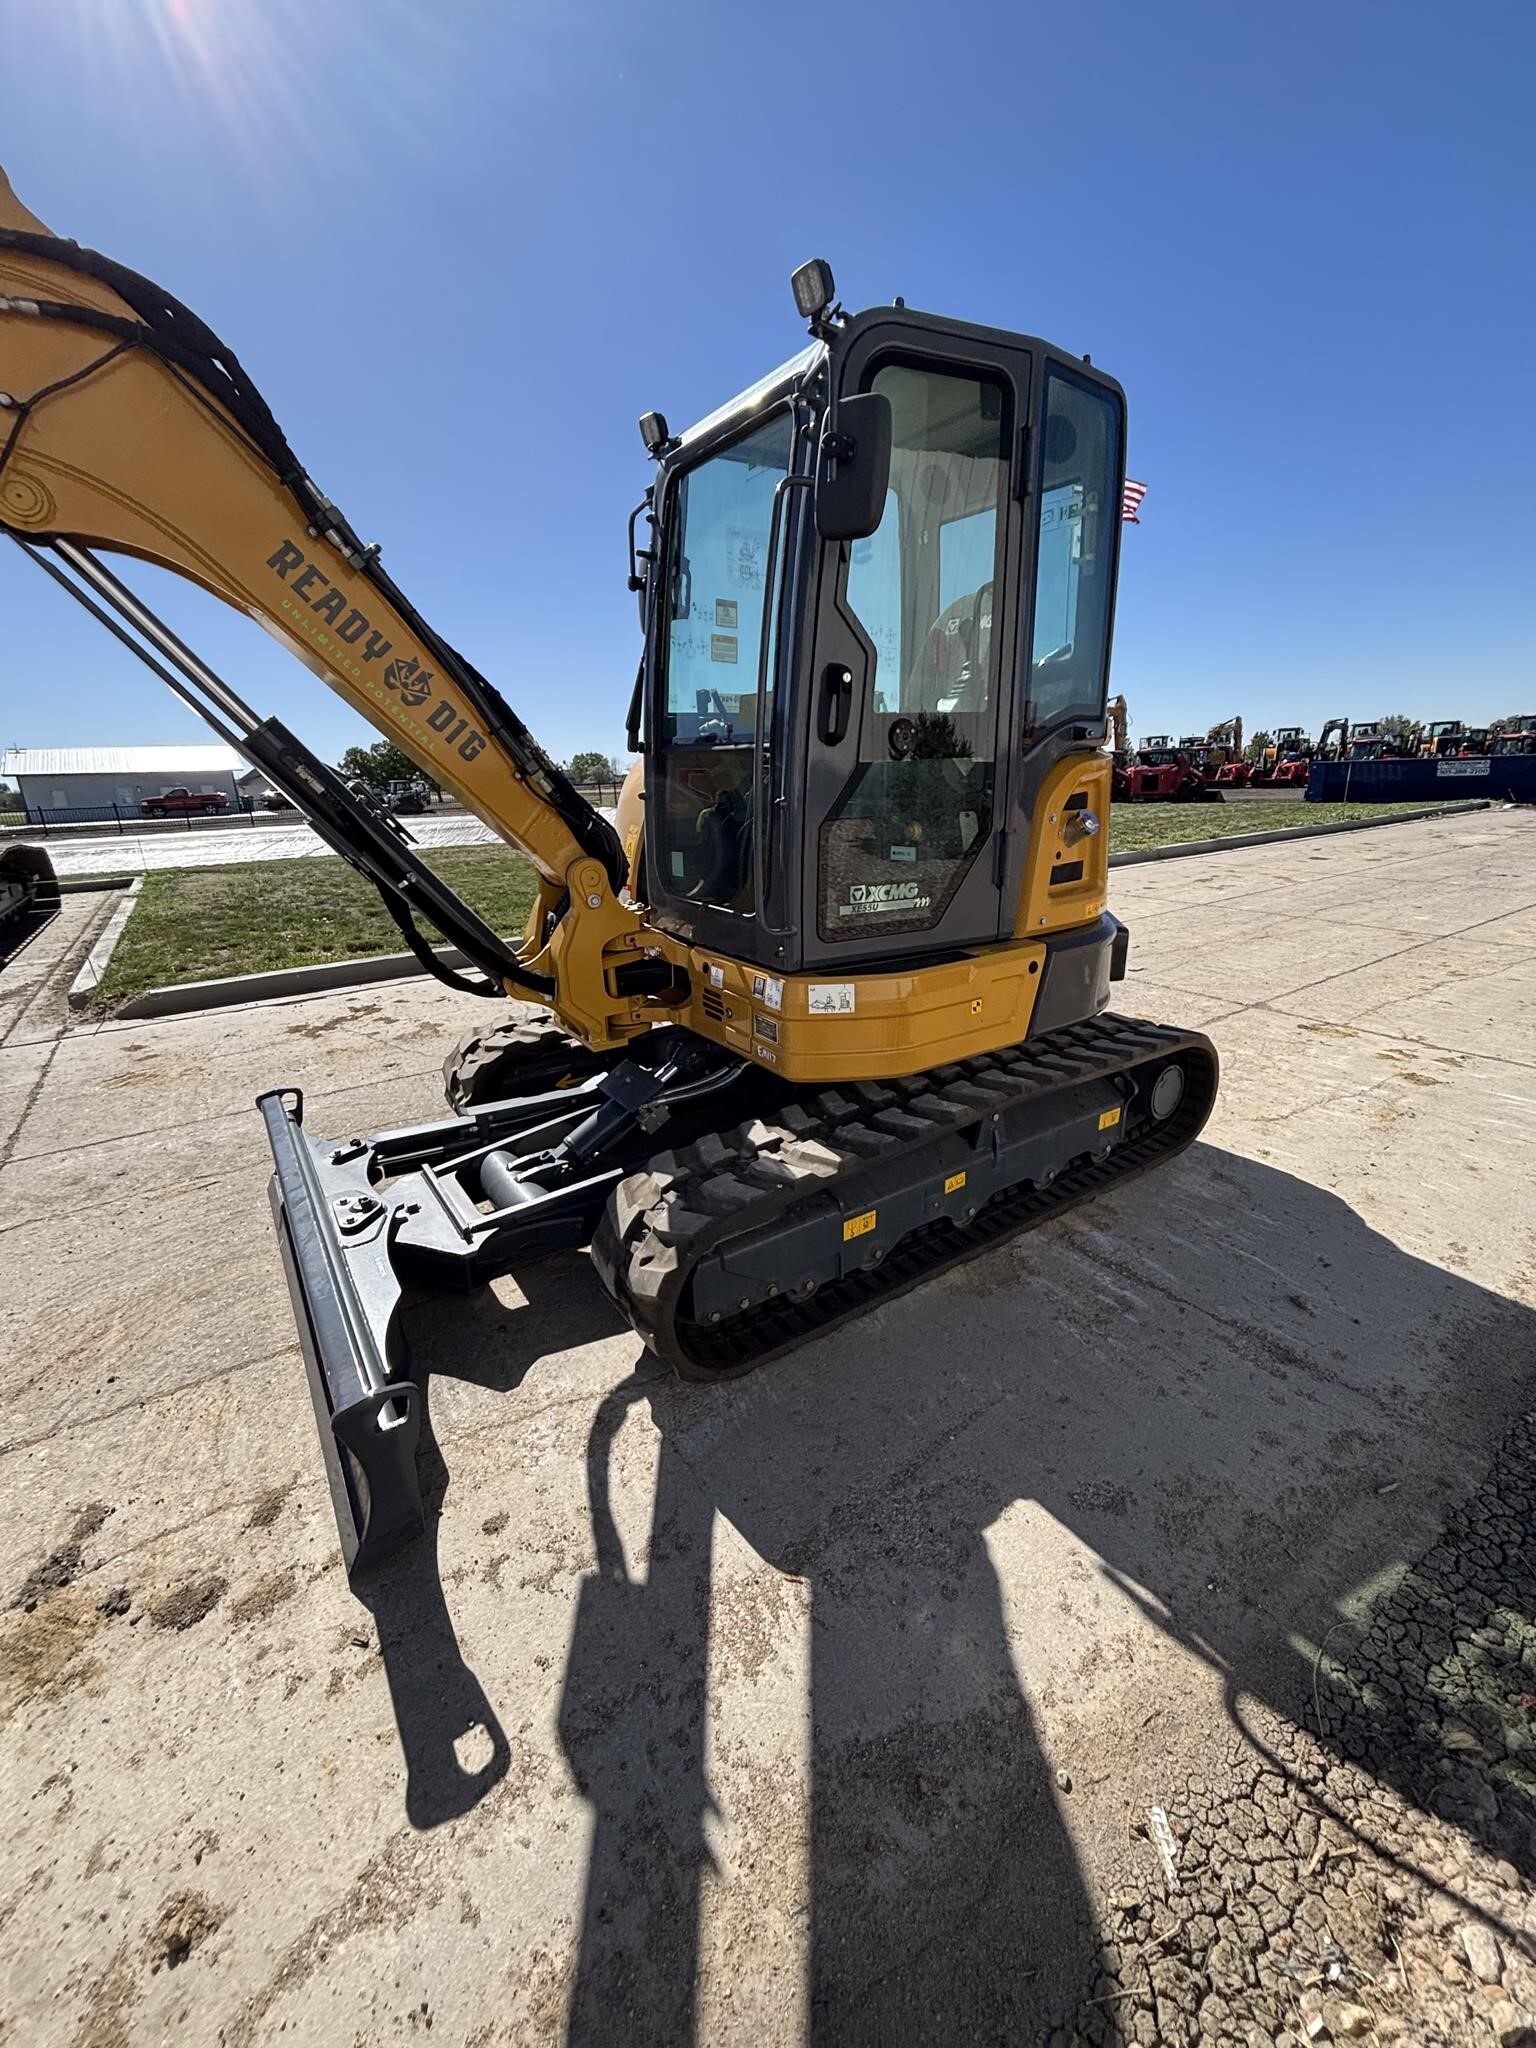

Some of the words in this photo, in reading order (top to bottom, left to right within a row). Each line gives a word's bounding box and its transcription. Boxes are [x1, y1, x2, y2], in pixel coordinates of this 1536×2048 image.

[266, 539, 393, 663] READY
[426, 699, 488, 762] DIG
[281, 599, 361, 676] UNLIMITED
[366, 680, 436, 751] POTENTIAL
[865, 881, 919, 903] XCMG
